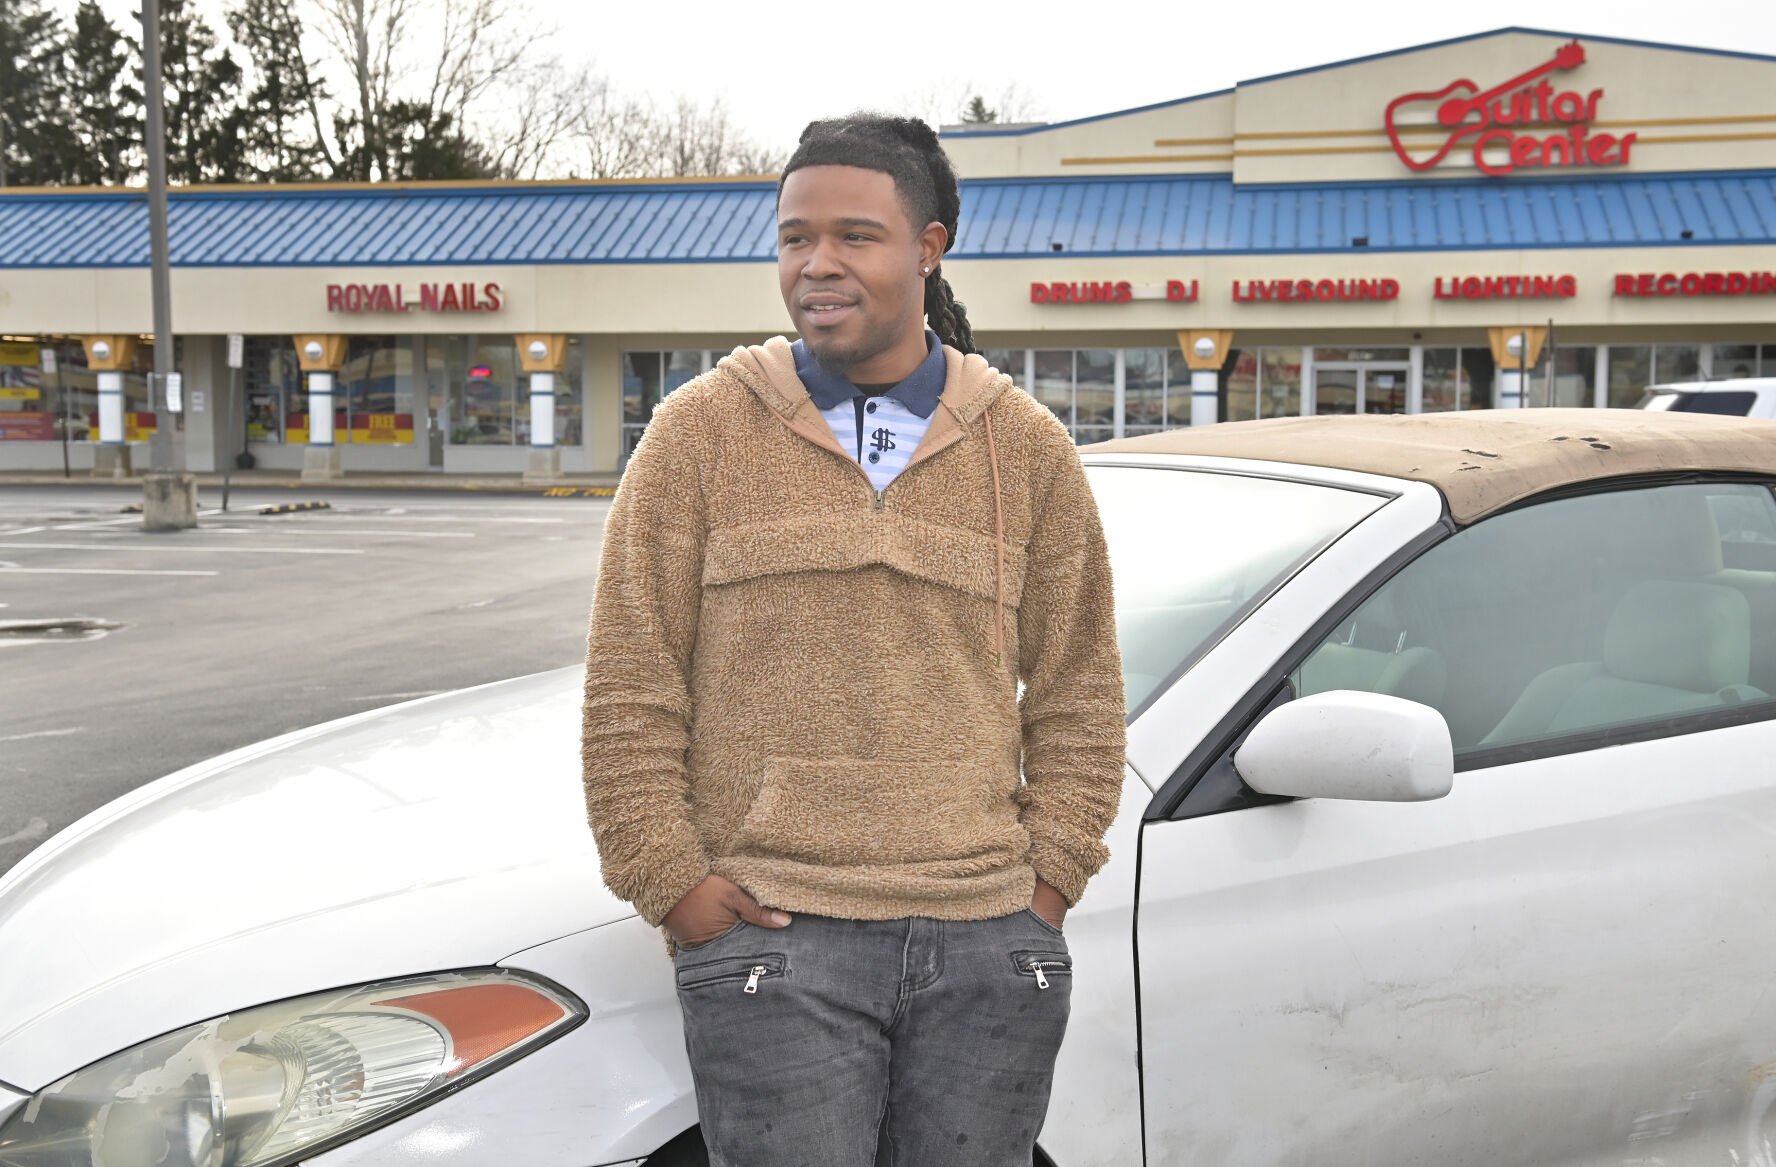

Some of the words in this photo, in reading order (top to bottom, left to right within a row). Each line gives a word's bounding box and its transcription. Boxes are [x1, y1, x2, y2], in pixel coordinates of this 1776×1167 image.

[1473, 125, 1637, 176] Center
[326, 284, 408, 313] ROYAL
[420, 283, 501, 311] NAILS
[1030, 282, 1133, 304] DRUMS
[1166, 280, 1199, 301] DJ
[1232, 278, 1400, 302] LIVESOUND
[1434, 275, 1576, 300] LIGHTING
